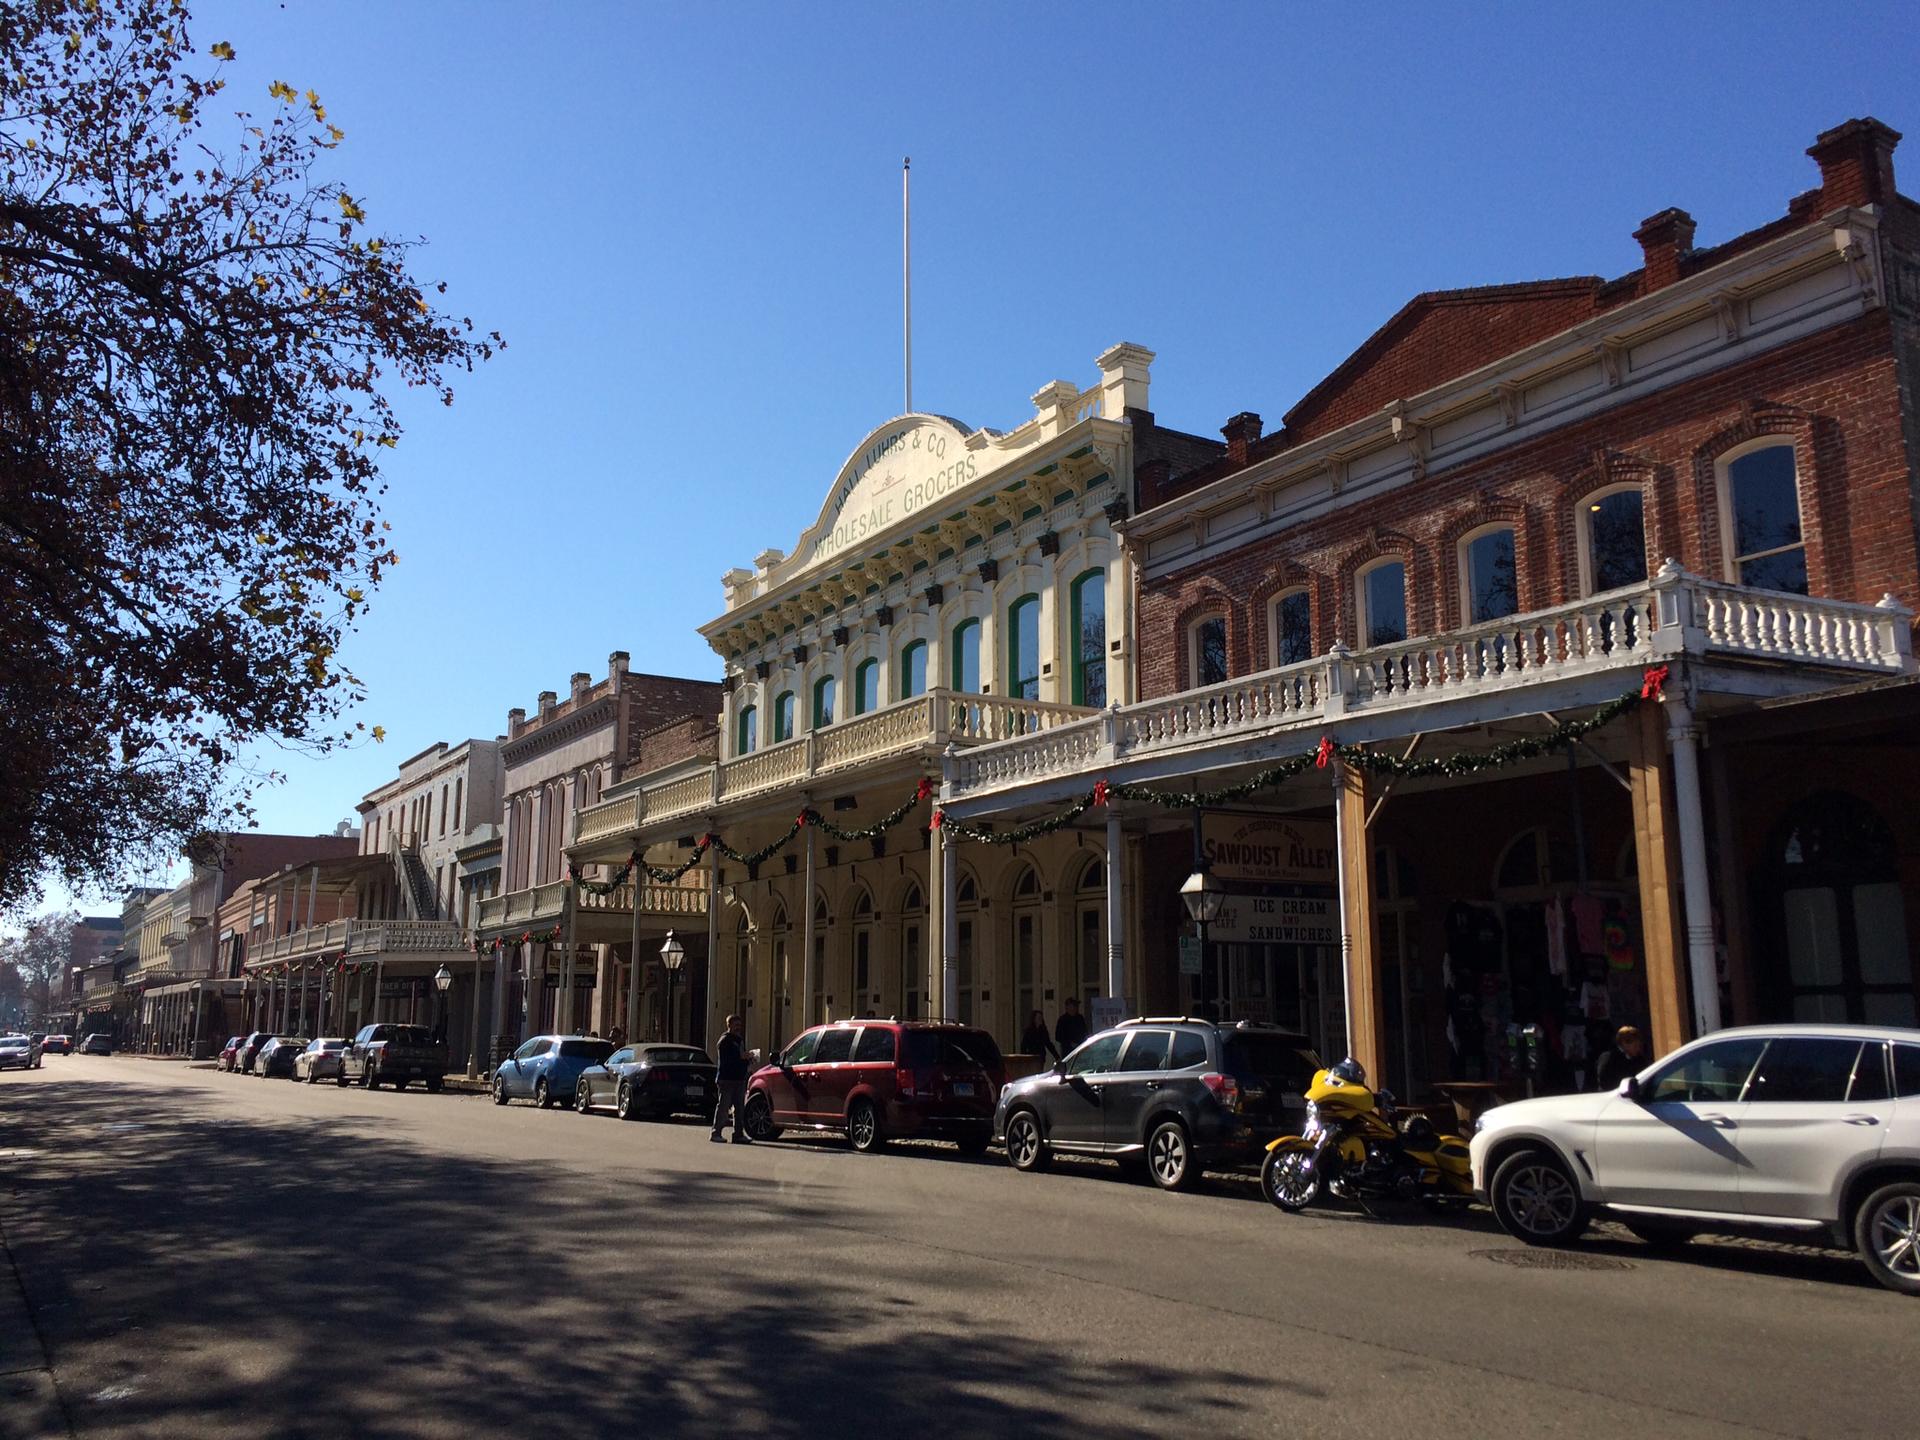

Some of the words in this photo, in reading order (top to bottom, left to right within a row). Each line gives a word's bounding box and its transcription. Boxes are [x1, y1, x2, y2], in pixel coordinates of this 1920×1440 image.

[866, 431, 906, 470] LUHRS
[911, 428, 922, 449] &
[814, 498, 894, 560] WHOLESALE
[1204, 838, 1281, 867] SAWDUST
[1288, 843, 1334, 869] ALLEY
[1253, 898, 1275, 913] ICE
[1282, 900, 1327, 915] CREAM
[1249, 926, 1333, 942] SANDWICHES
